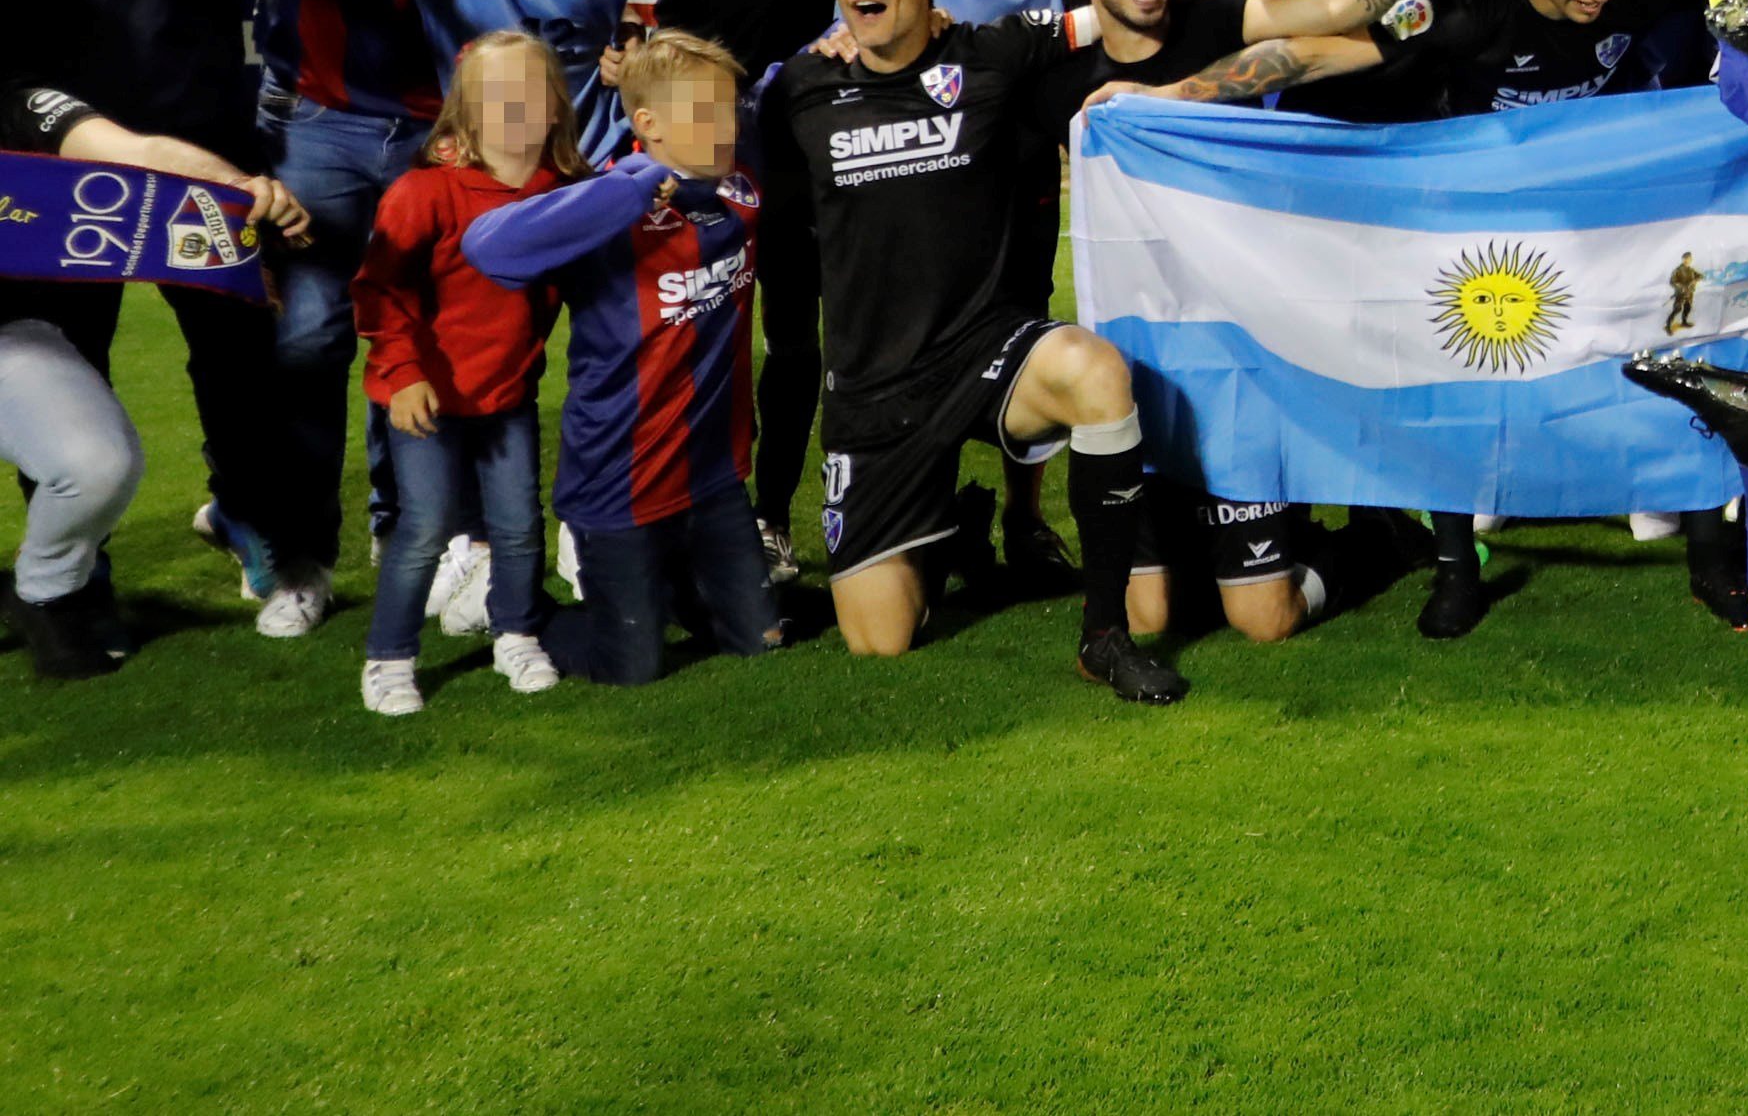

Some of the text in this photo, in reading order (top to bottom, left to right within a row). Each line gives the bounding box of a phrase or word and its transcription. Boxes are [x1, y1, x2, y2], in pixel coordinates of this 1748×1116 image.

[833, 152, 972, 188] supermercados
[59, 170, 130, 268] 1910
[197, 189, 226, 232] HUESCA
[120, 239, 146, 277] Sociedad
